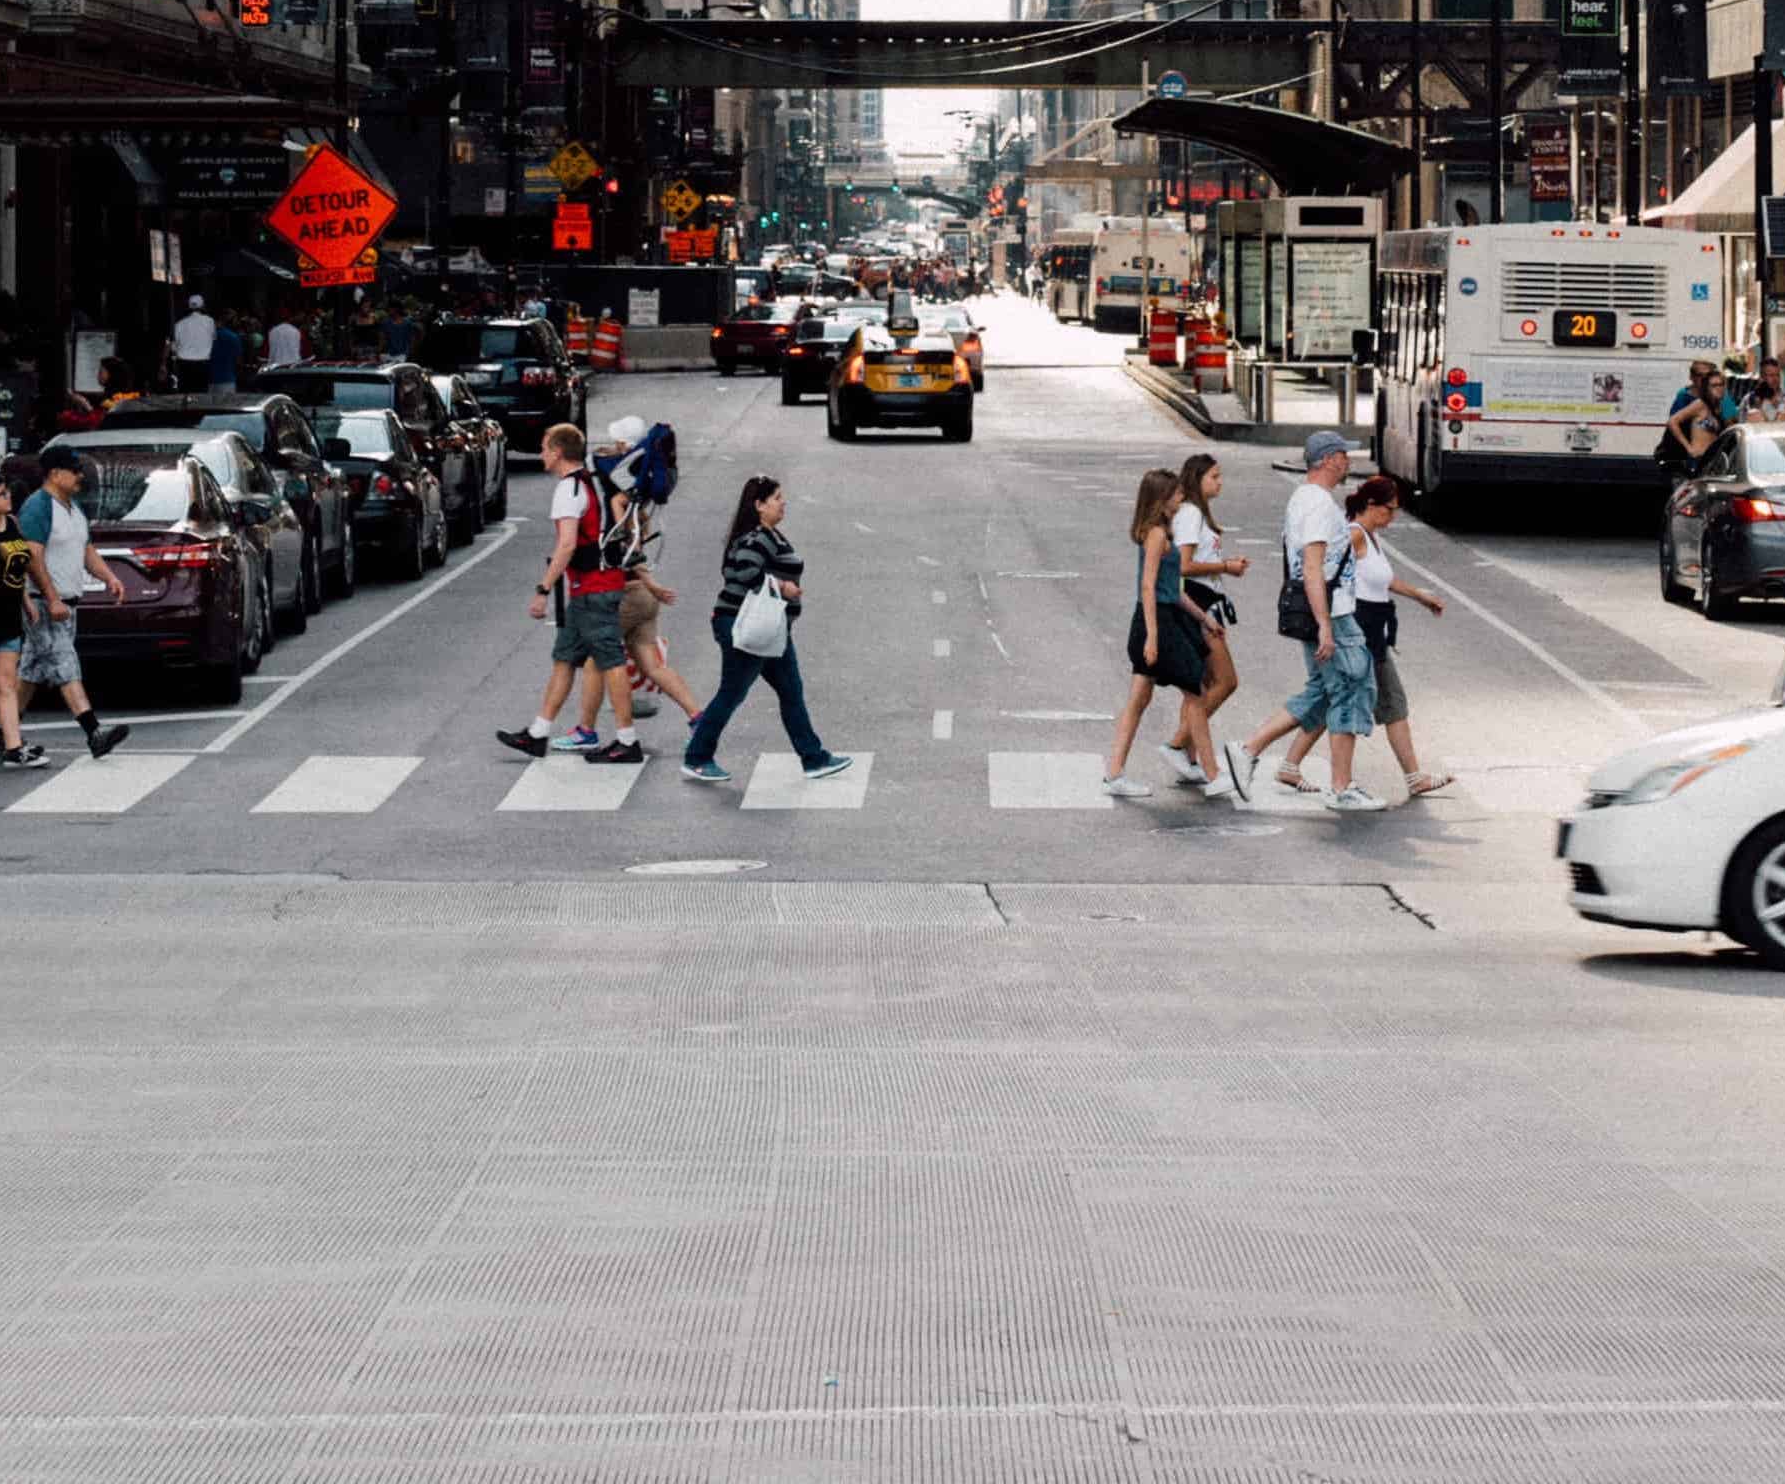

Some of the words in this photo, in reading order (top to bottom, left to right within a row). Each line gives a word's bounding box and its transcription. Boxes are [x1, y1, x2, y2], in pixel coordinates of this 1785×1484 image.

[1571, 0, 1607, 13] hear.
[290, 190, 370, 215] DETOUR
[297, 217, 370, 241] AHEAD
[1571, 315, 1596, 336] 20
[1682, 335, 1719, 349] 1986
